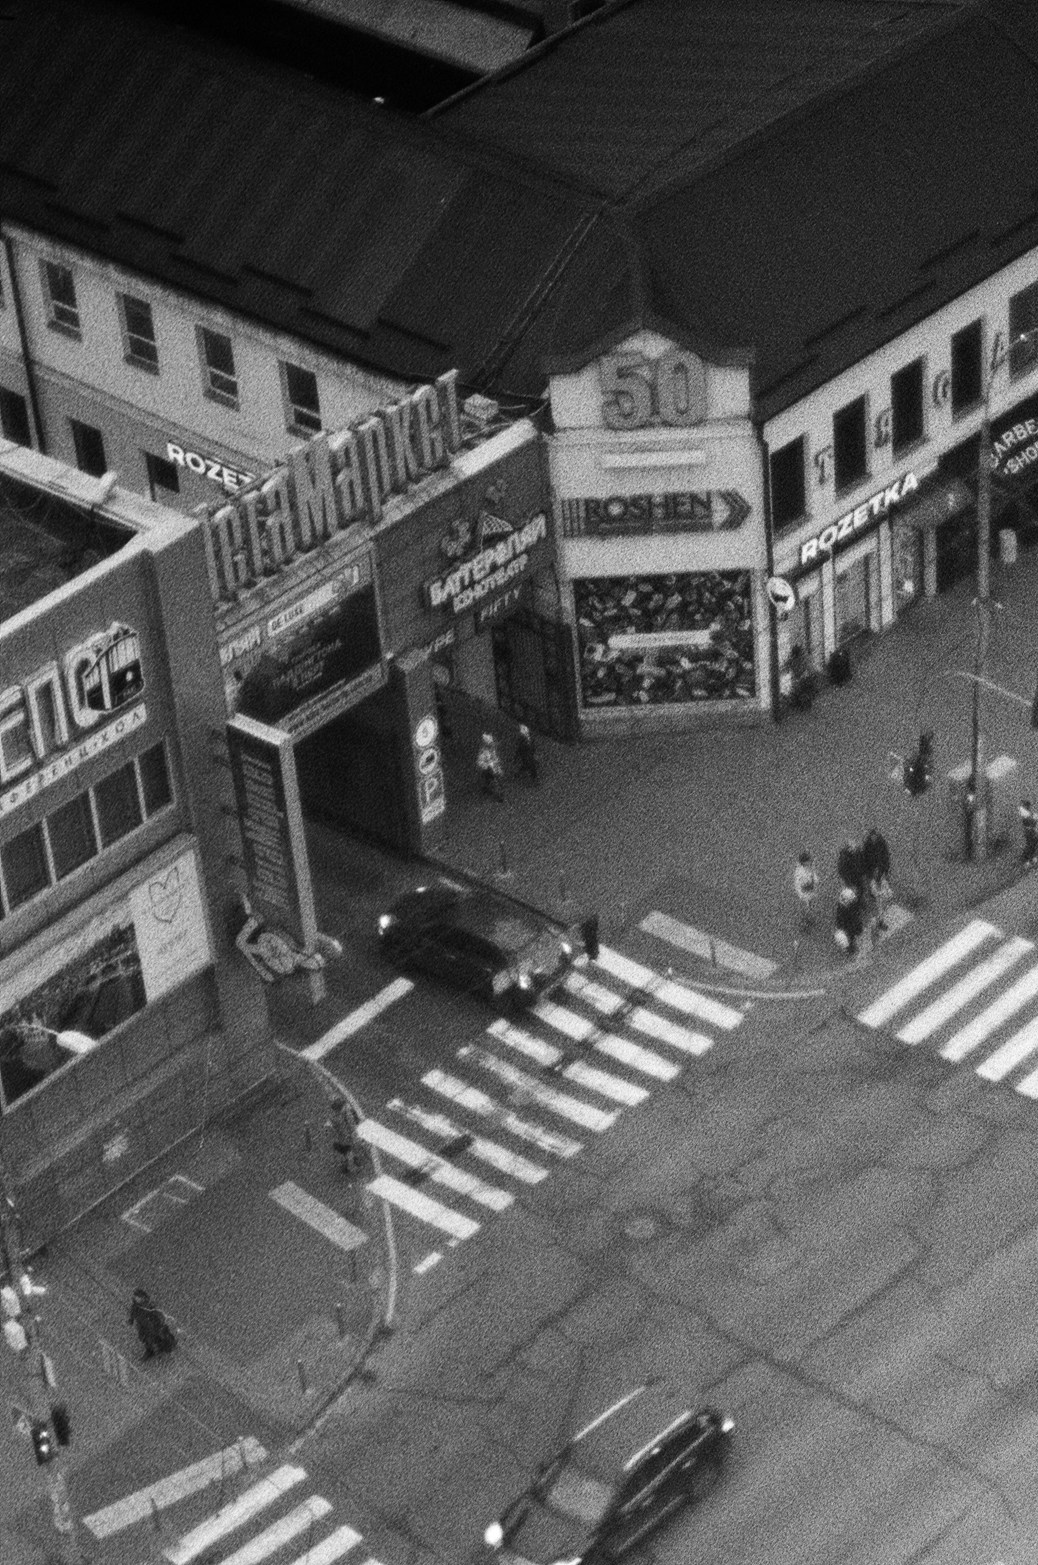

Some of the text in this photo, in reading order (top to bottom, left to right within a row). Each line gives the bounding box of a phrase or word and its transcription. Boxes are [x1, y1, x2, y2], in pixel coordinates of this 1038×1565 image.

[600, 350, 708, 430] 50
[584, 491, 713, 523] ROSHEN
[801, 473, 919, 563] ROZETKA
